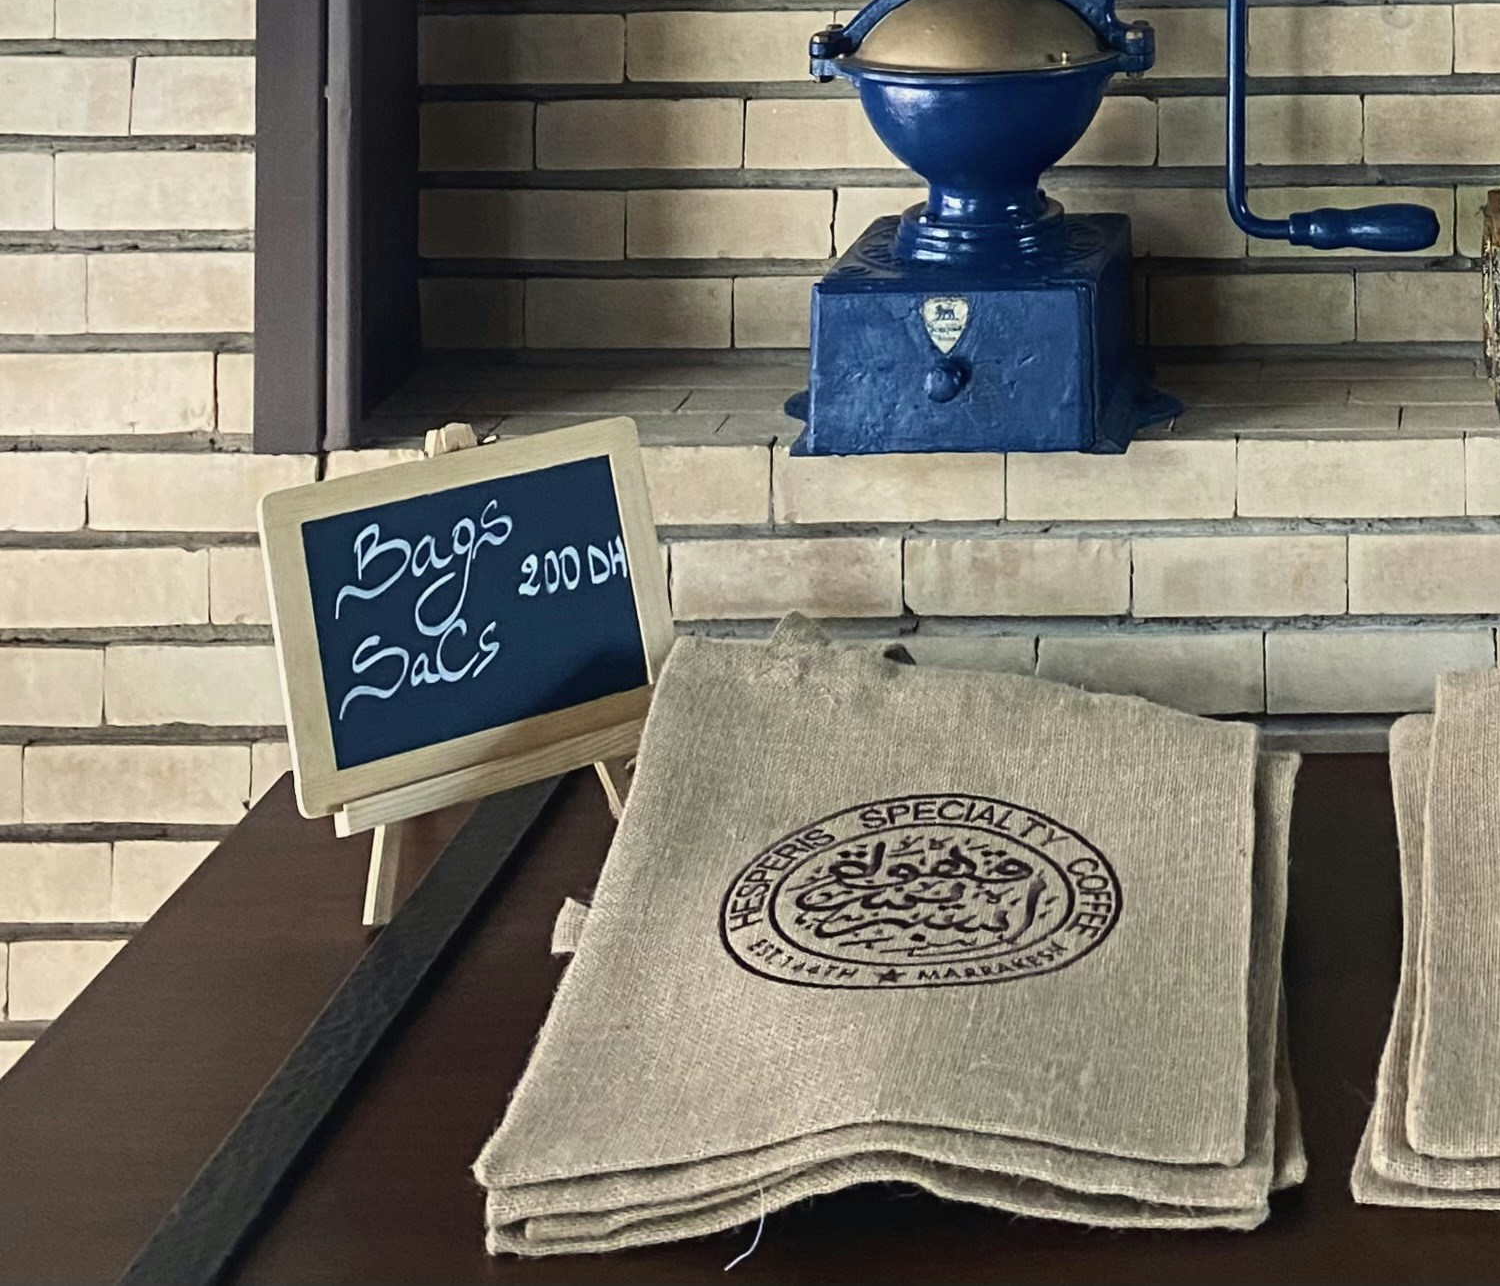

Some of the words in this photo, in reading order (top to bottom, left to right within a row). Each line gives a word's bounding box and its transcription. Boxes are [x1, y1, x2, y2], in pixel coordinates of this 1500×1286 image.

[335, 499, 513, 637] Bags
[518, 544, 581, 597] 200
[588, 534, 629, 586] DH
[730, 827, 835, 932] HESPERIS
[859, 799, 1069, 848] SPECIALTY
[1066, 857, 1112, 937] COFFEE
